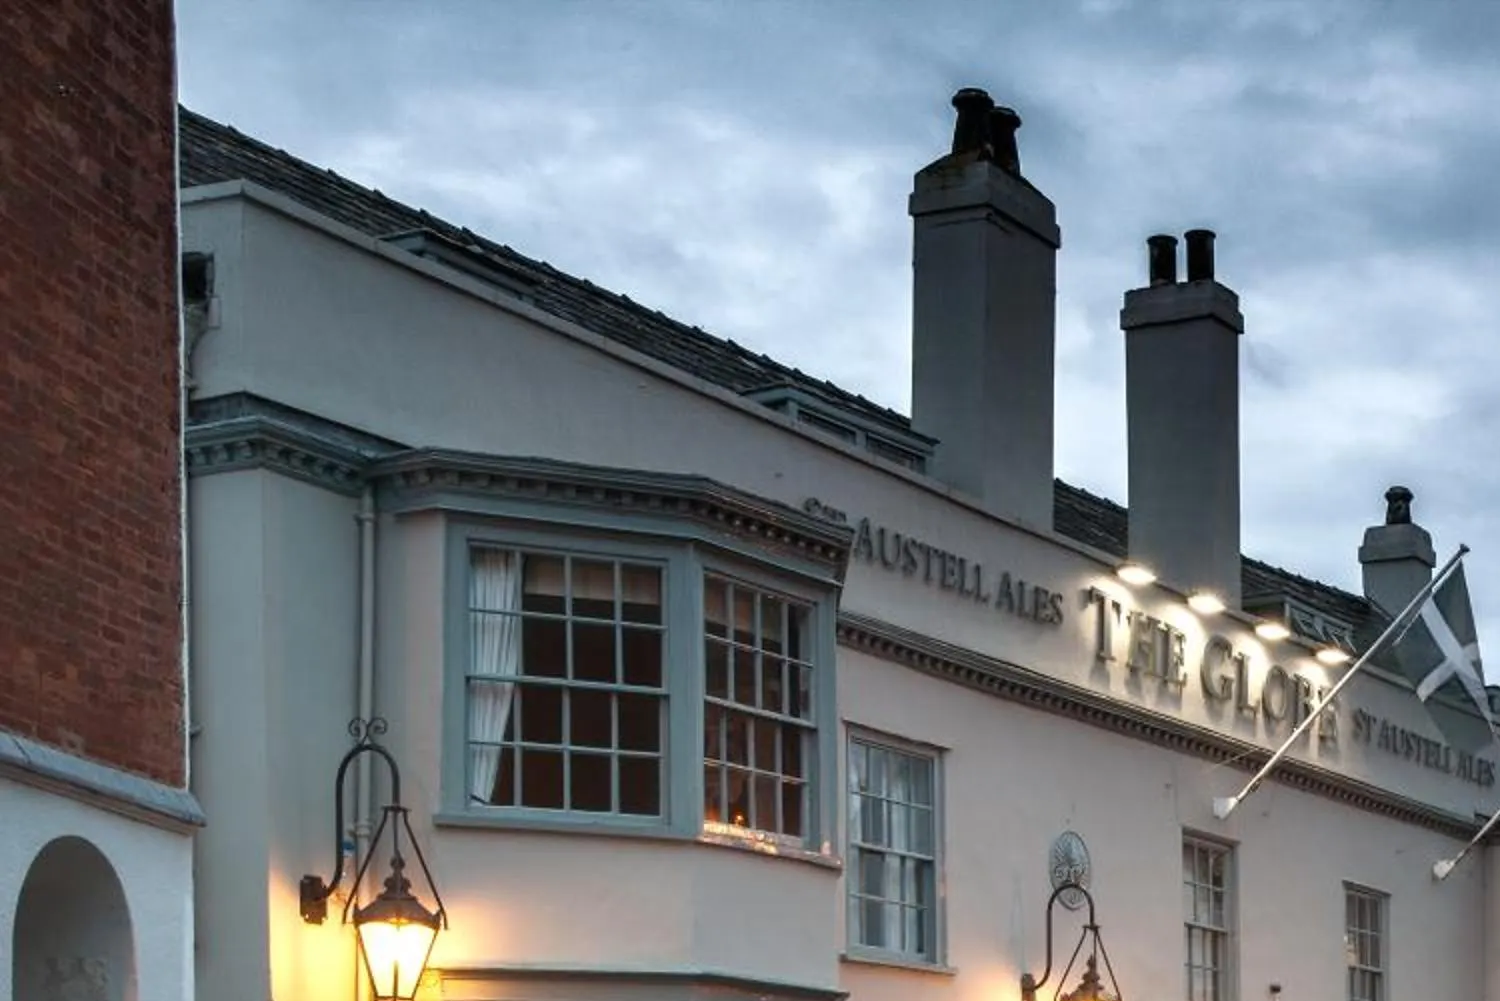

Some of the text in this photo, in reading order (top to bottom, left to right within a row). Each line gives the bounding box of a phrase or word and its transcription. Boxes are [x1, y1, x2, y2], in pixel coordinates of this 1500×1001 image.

[853, 517, 990, 603] AUSTELL
[994, 571, 1064, 626] ALES
[1083, 585, 1188, 689] THE
[1378, 719, 1451, 774] AUSTELL
[1456, 752, 1496, 786] ALES
